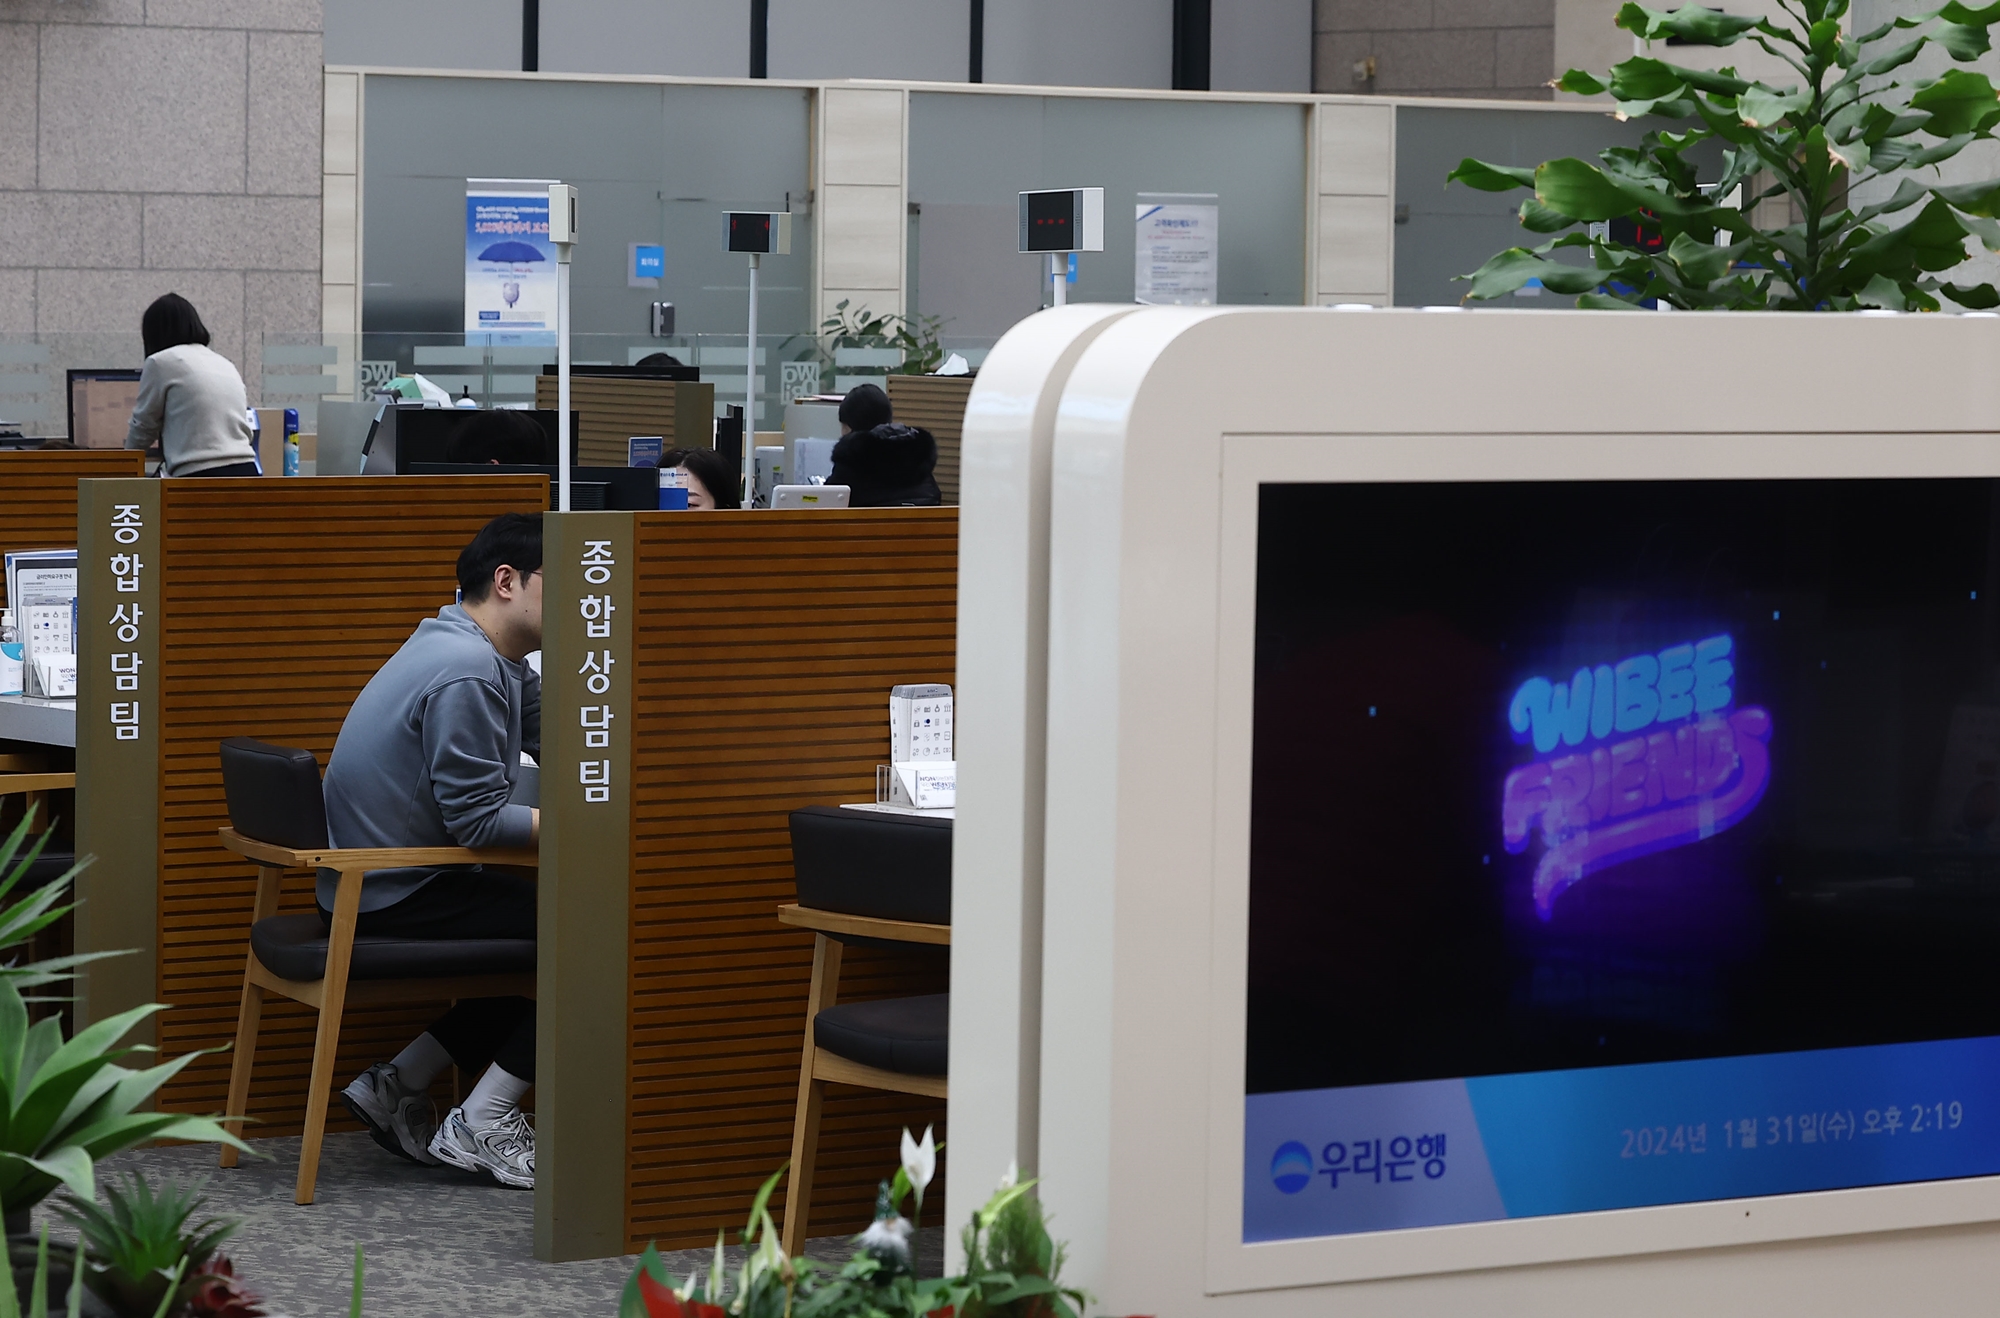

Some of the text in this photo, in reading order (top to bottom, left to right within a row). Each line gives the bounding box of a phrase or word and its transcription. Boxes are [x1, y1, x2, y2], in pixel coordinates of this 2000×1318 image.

[109, 504, 144, 741] 종합상담팀
[578, 540, 616, 803] 종합상담팀
[1509, 633, 1734, 753] WIBEE
[1503, 704, 1773, 915] FRIENDS
[494, 1138, 522, 1158] N
[1318, 1133, 1446, 1189] 우리은행
[1620, 1101, 1963, 1159] 2024년 1월 31일(수) 오후 2:19
